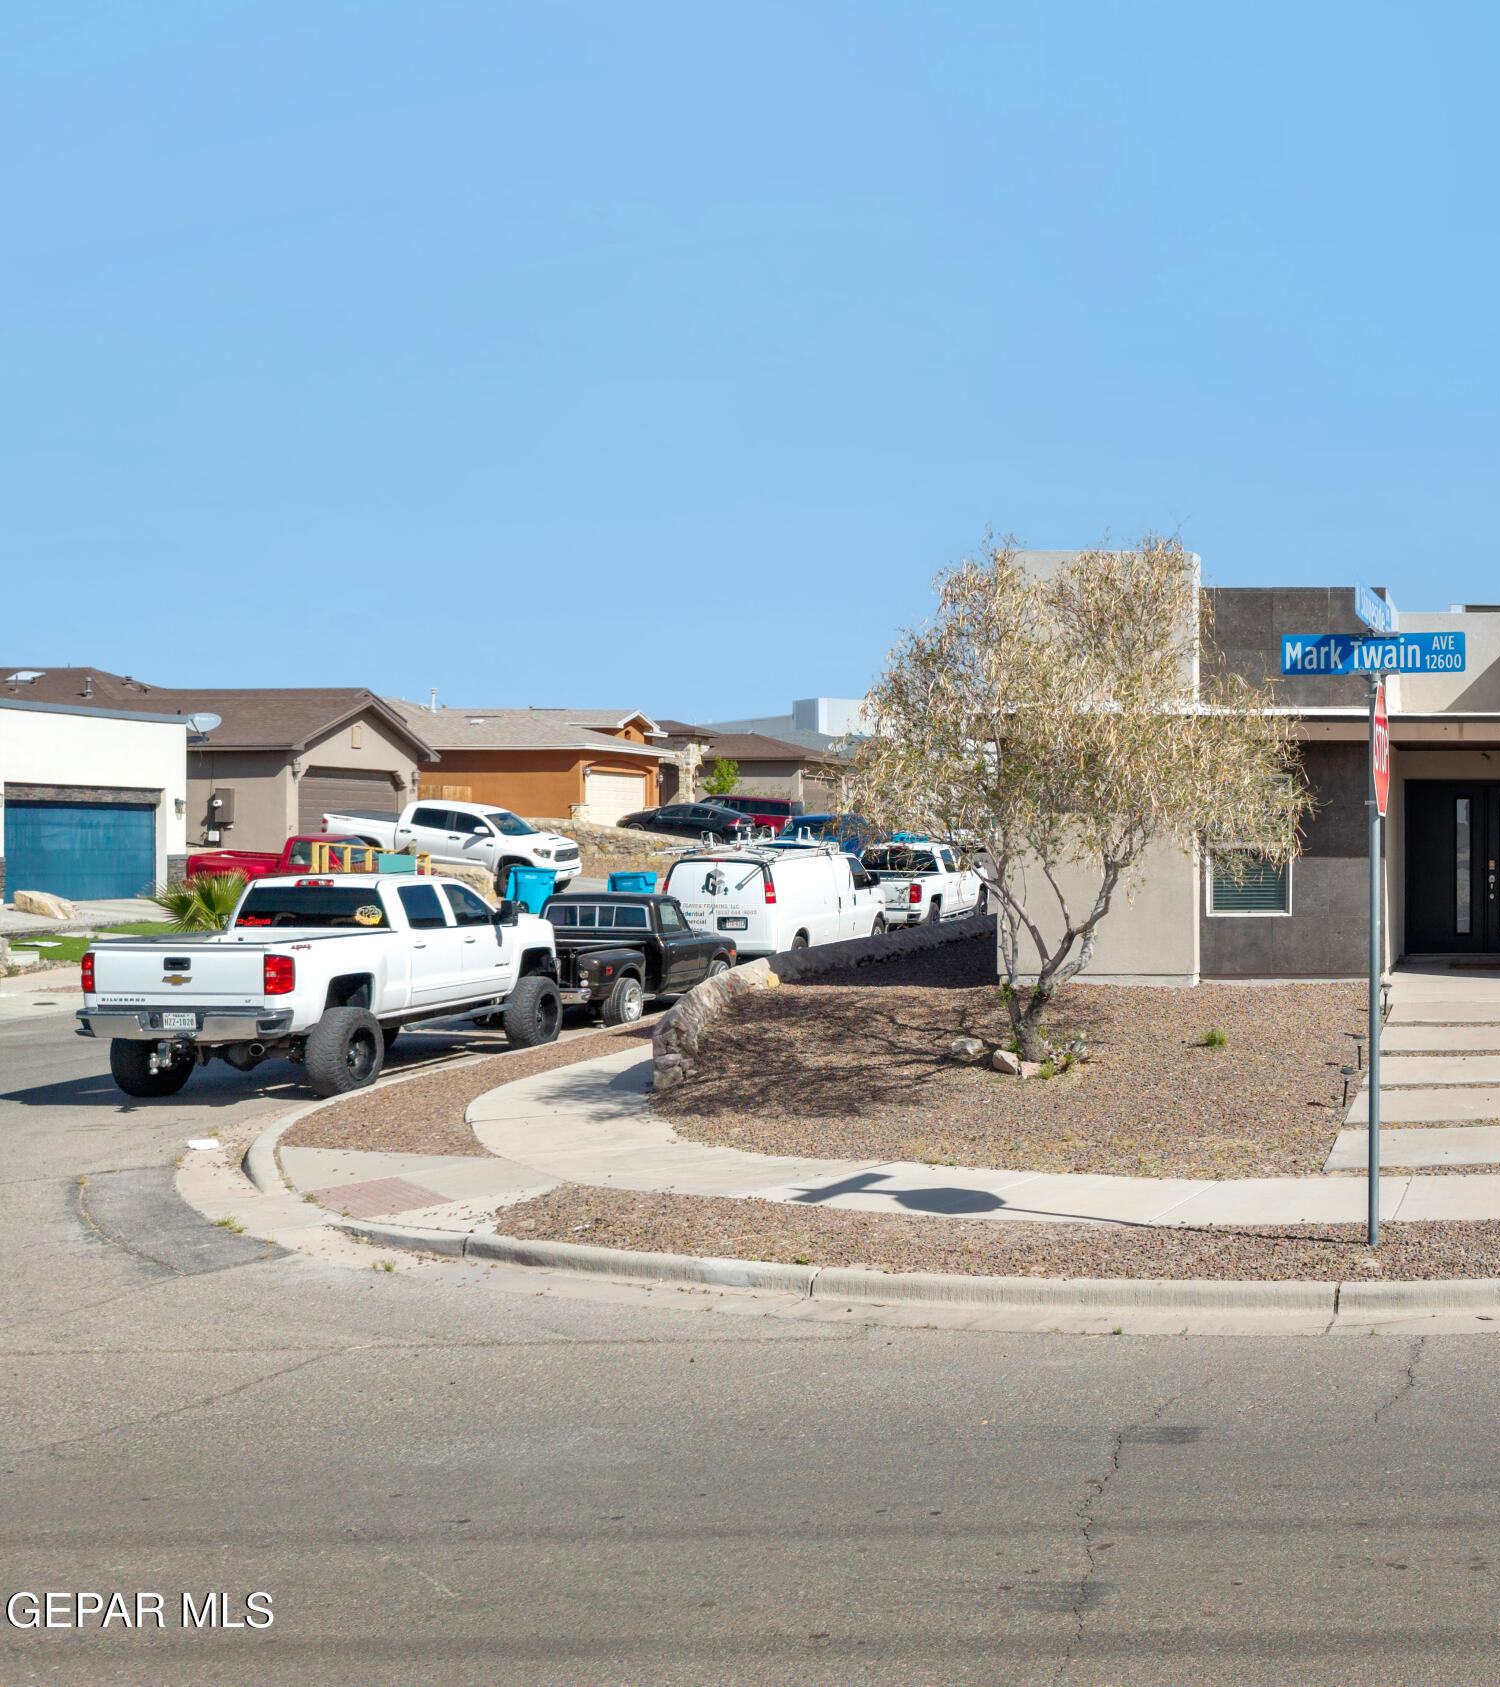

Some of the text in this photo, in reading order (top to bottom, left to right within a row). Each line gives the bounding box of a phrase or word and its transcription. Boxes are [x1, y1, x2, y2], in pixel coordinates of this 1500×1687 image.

[1285, 637, 1421, 670] Mark Twain
[1431, 635, 1455, 651] AVE
[1425, 654, 1462, 669] 12600
[1375, 723, 1388, 775] STOP
